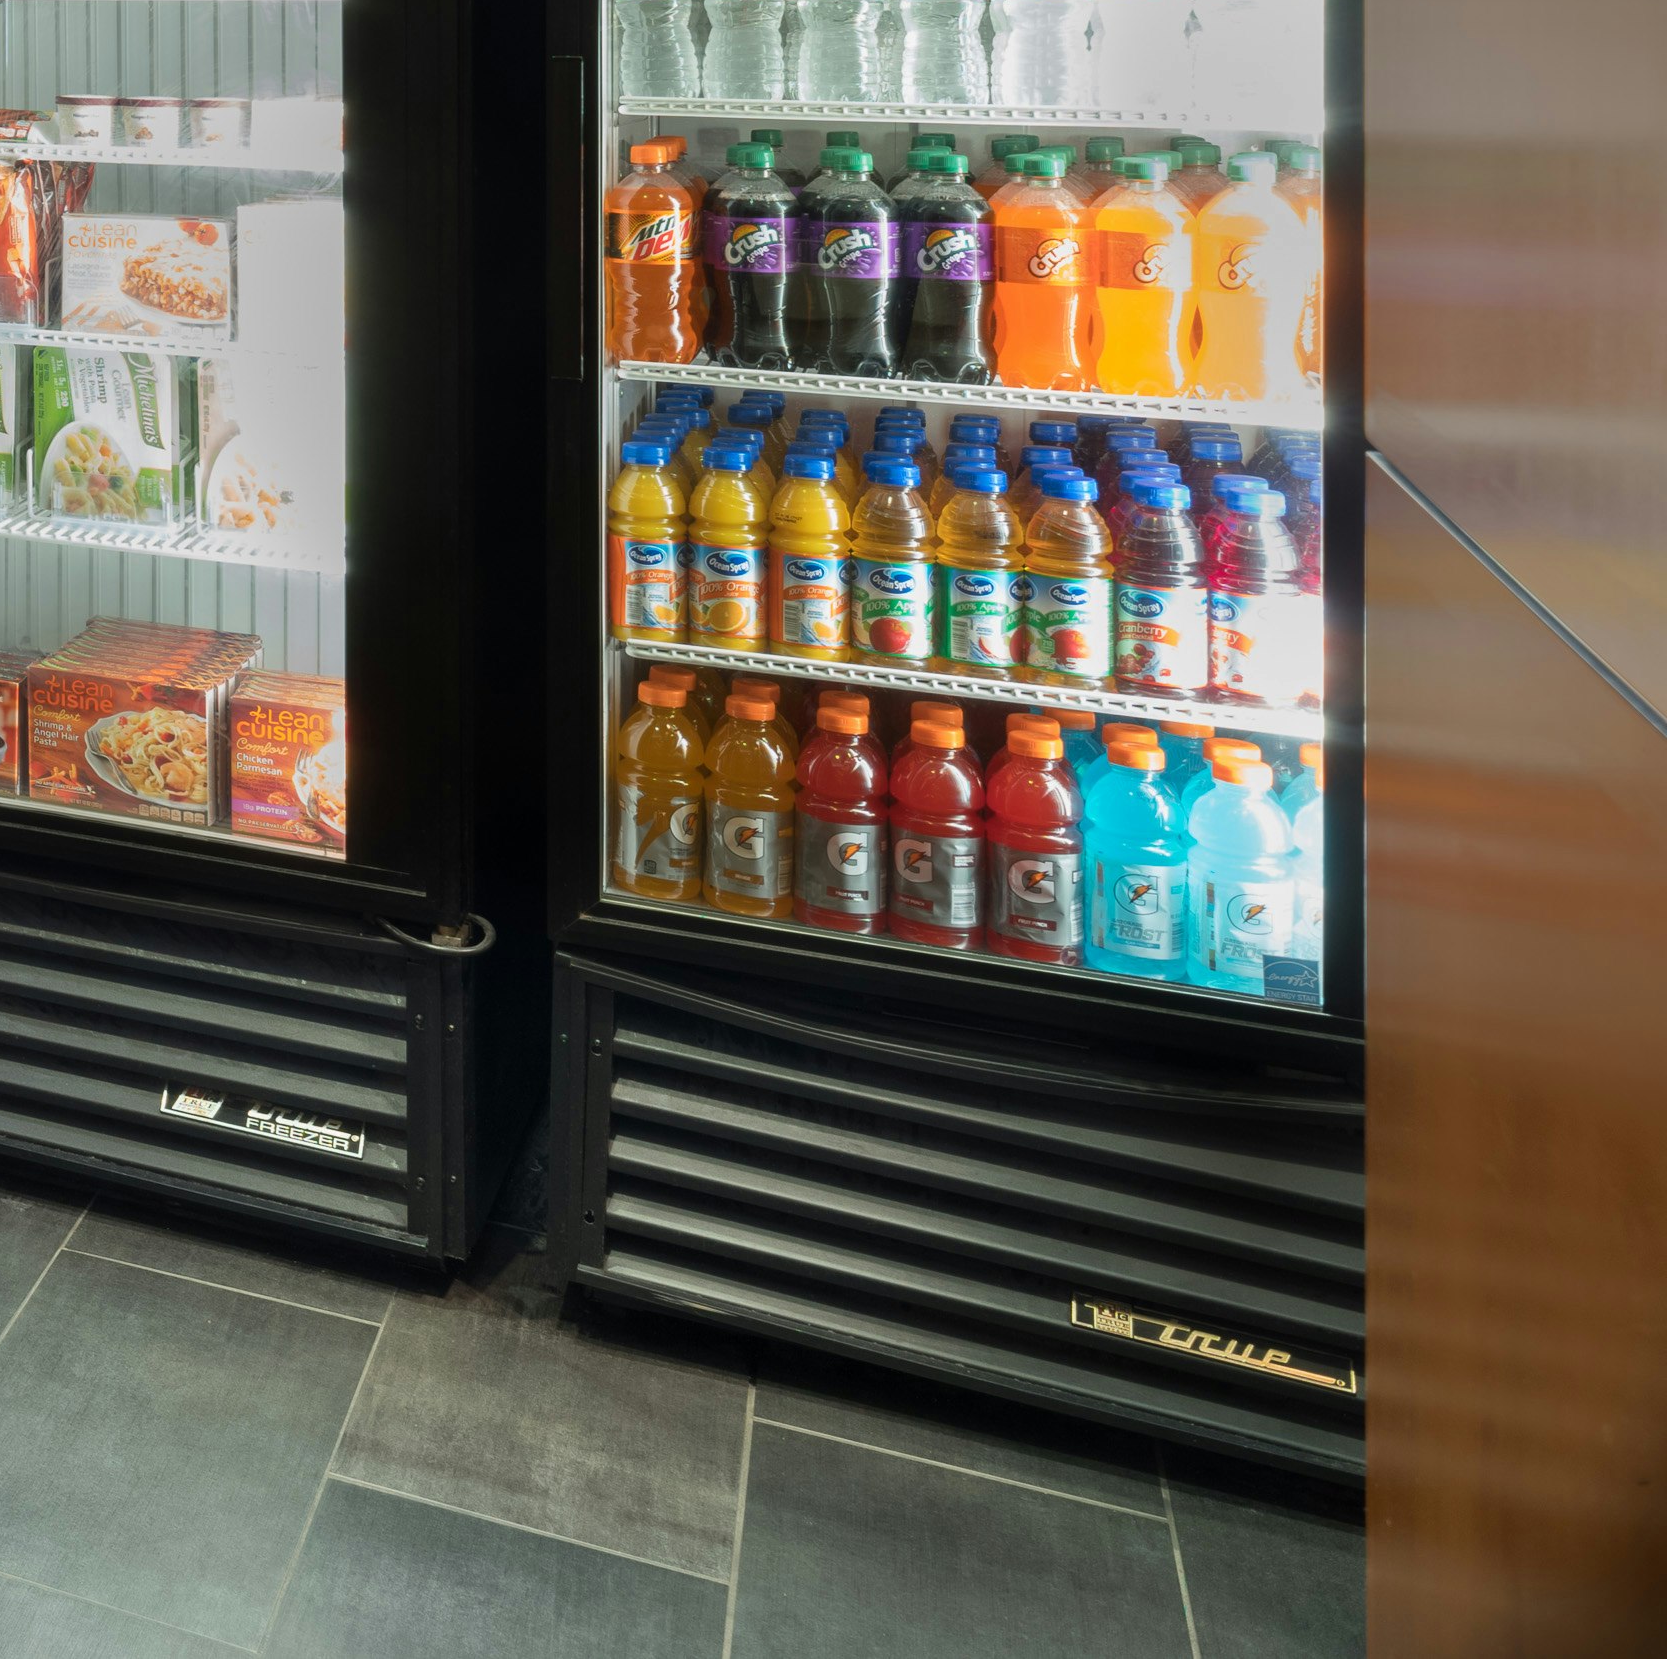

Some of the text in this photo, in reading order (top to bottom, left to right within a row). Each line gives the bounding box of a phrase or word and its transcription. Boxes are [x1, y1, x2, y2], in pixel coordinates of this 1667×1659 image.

[724, 224, 780, 265] Crush
[818, 228, 873, 269] Crush
[918, 229, 975, 272] Crush
[746, 245, 770, 264] Grape
[839, 248, 862, 269] Grape
[942, 250, 966, 271] Grape
[94, 357, 108, 405] Shrimp
[127, 353, 159, 444] Michelina's
[709, 557, 750, 574] Ocean Spray
[789, 565, 823, 577] Ocean Spray
[700, 581, 759, 597] 100% Orange
[872, 575, 915, 591] Ocean Spray
[957, 580, 994, 594] Ocean Spray
[1052, 589, 1071, 601] Ocean
[865, 601, 890, 612] 100%
[979, 602, 1004, 614] Apple
[1120, 597, 1164, 615] Ocean Spray
[1118, 622, 1168, 640] Cranberry
[62, 677, 113, 698] Lean
[33, 704, 82, 722] Comfort
[268, 708, 325, 731] Lean
[33, 719, 65, 732] Shrimp
[33, 736, 58, 747] Pasta
[34, 728, 80, 742] Angel Hair
[236, 737, 289, 757] Comfort
[236, 752, 274, 765] Chicken
[236, 762, 283, 776] Parmesan
[255, 805, 288, 817] PROTEIN
[1109, 923, 1166, 942] FROST
[1298, 993, 1317, 1003] STAR
[247, 1118, 350, 1151] FREEZER
